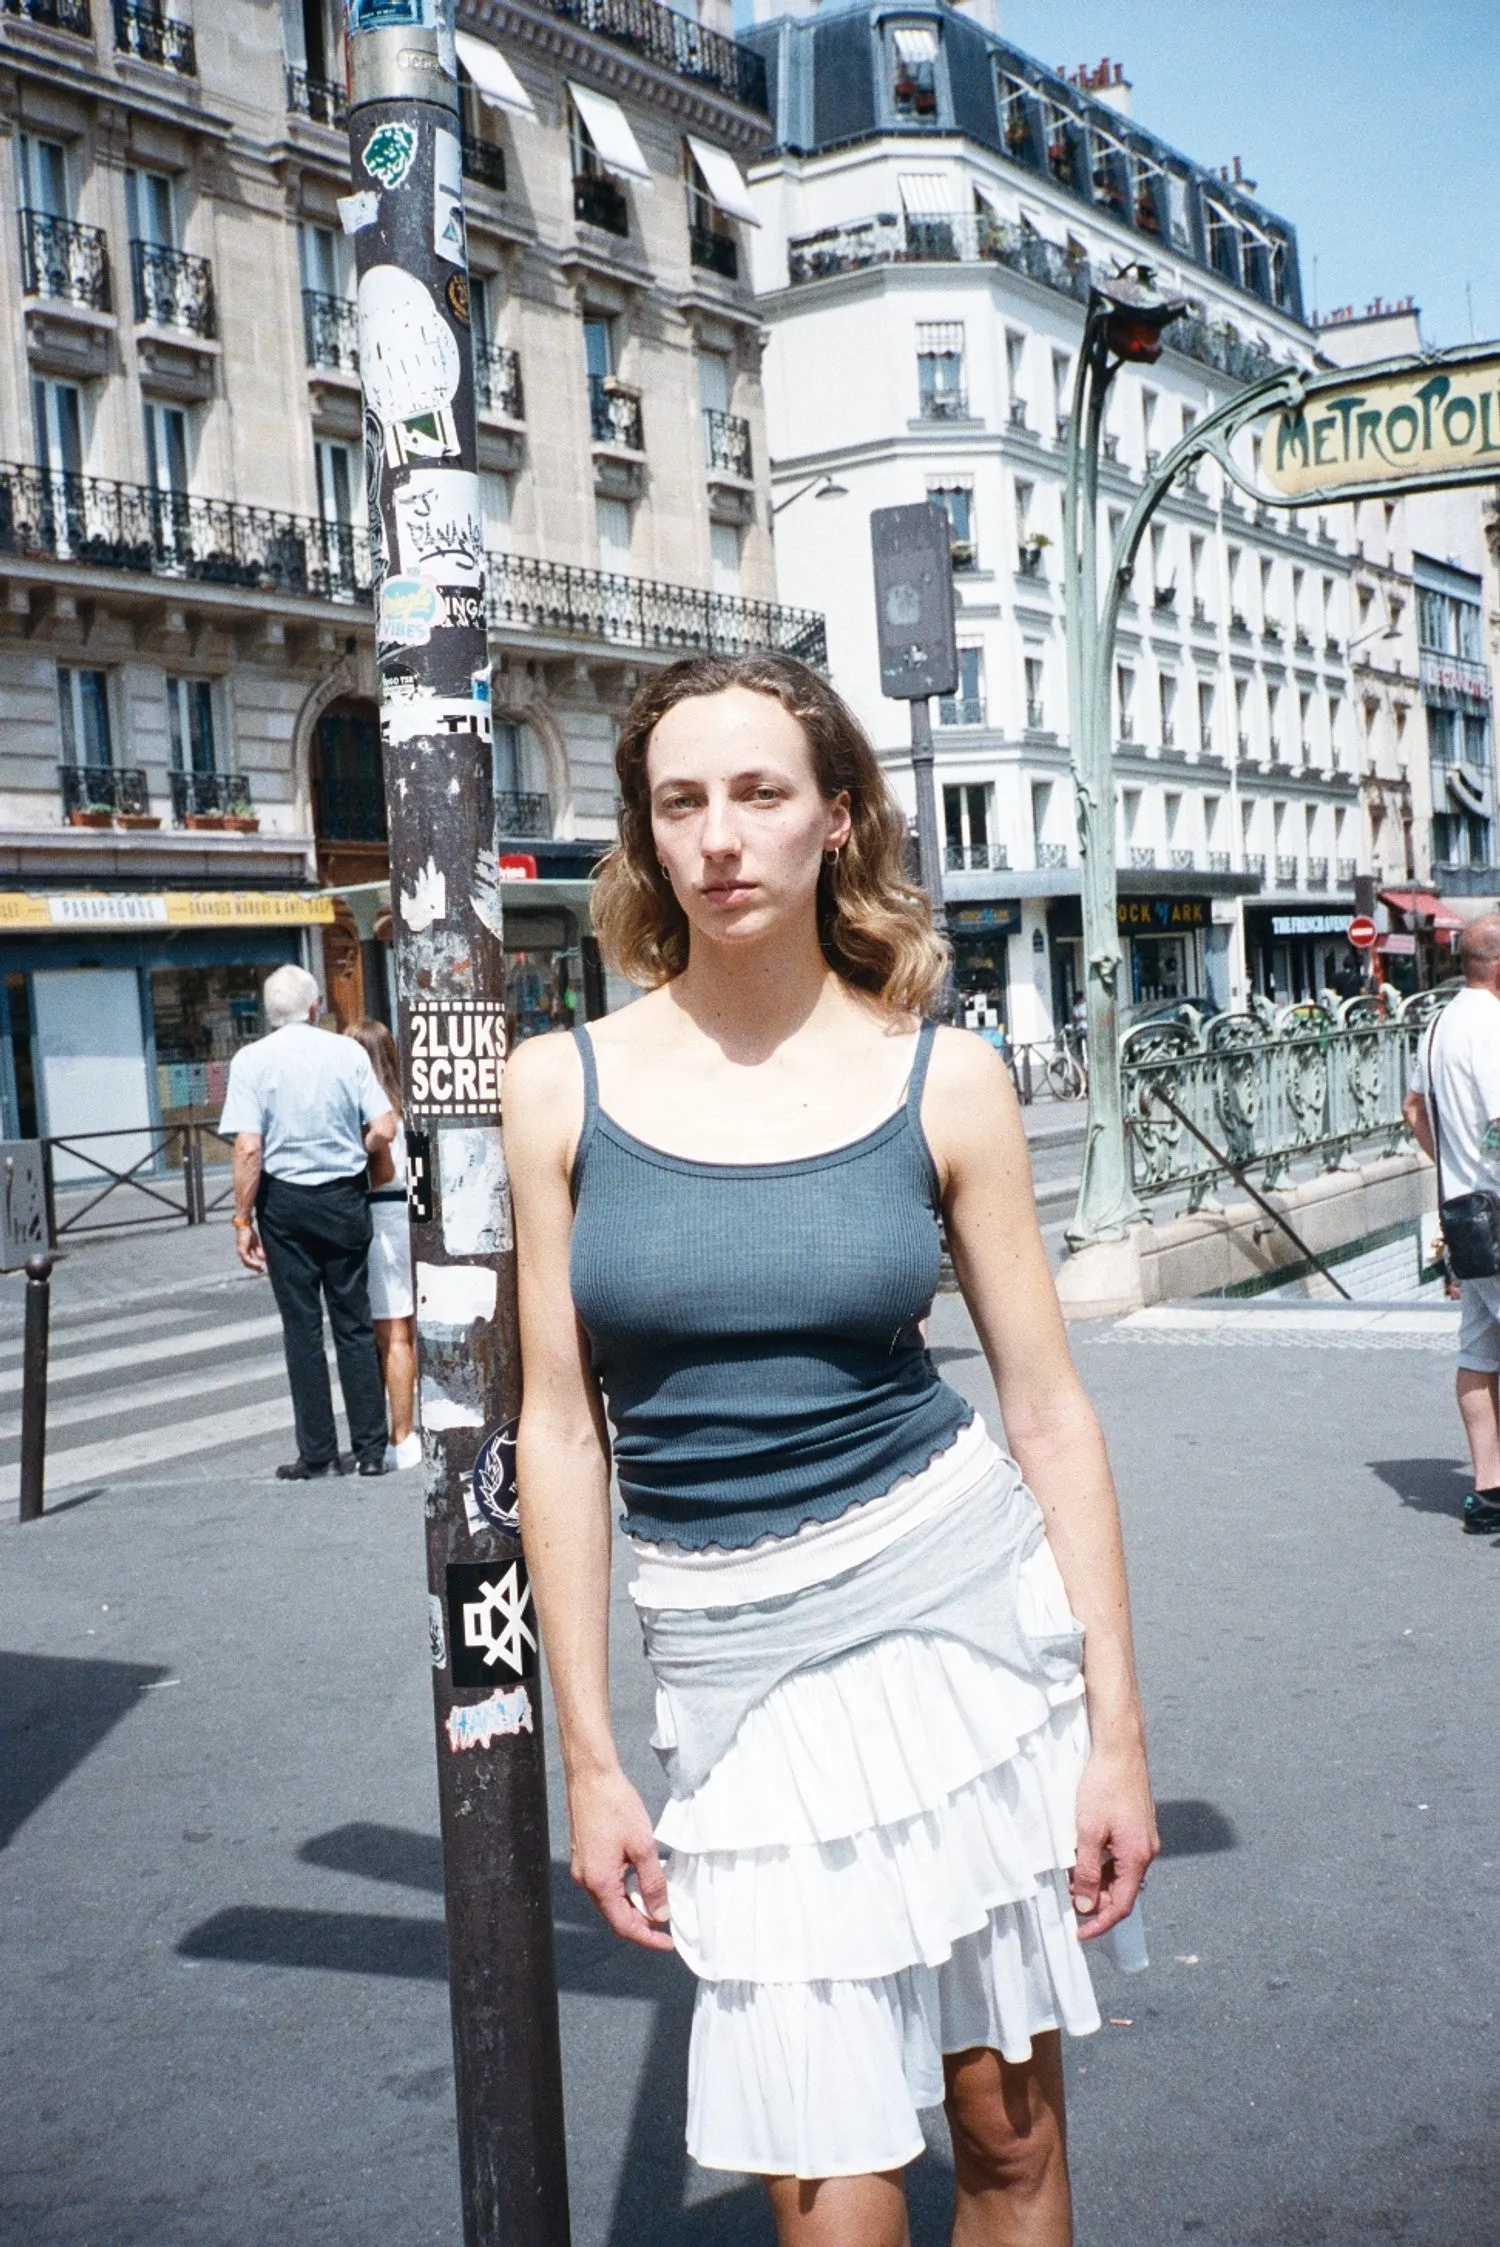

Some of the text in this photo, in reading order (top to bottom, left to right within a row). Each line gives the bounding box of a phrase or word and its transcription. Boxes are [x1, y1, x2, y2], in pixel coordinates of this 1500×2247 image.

[1277, 374, 1500, 471] METROPOL
[1118, 903, 1150, 922] OCK
[411, 1015, 506, 1057] 2LUKS
